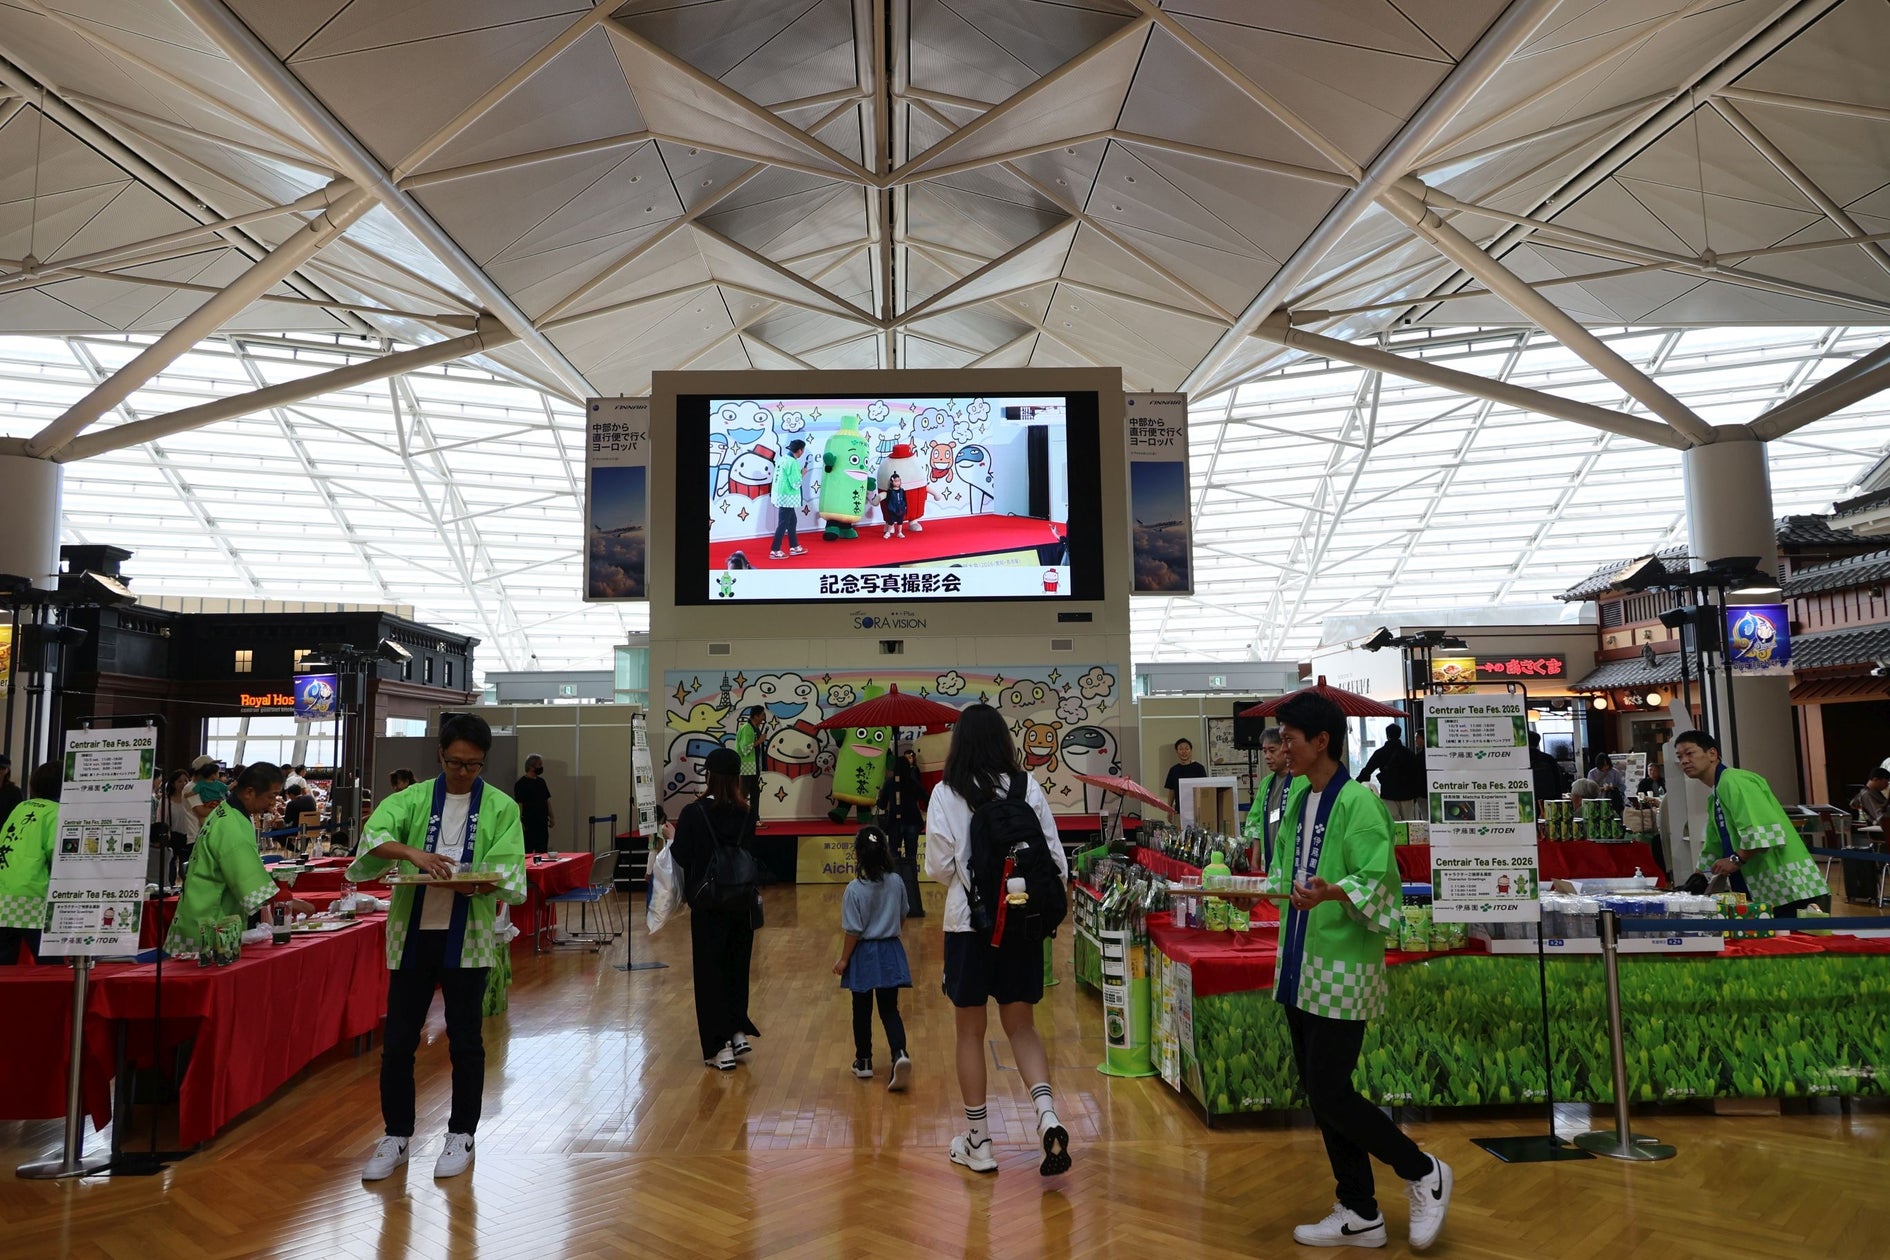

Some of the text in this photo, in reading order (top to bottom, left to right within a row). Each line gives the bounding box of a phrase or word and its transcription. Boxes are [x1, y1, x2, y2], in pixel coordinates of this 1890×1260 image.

[592, 423, 629, 432] 中部から
[1129, 418, 1165, 427] 中部から
[592, 432, 646, 442] 直行便で行く
[1129, 427, 1183, 437] 直行便で行く
[592, 442, 638, 451] ヨーロッパ
[1130, 437, 1174, 446] ヨーロッパ
[819, 573, 962, 594] 記念写真撮影会
[853, 616, 927, 629] SORA VISION
[240, 694, 272, 708] Royal
[1429, 705, 1520, 715] Centrair Tea Fes. 2026
[69, 738, 152, 749] Centrair Tea Fes. 2026
[1432, 780, 1529, 790] Centrair Tea Fes. 2026
[1436, 857, 1533, 867] Centrair Tea Fes. 2026
[52, 890, 139, 899] Centrair Tea Fes. 2026
